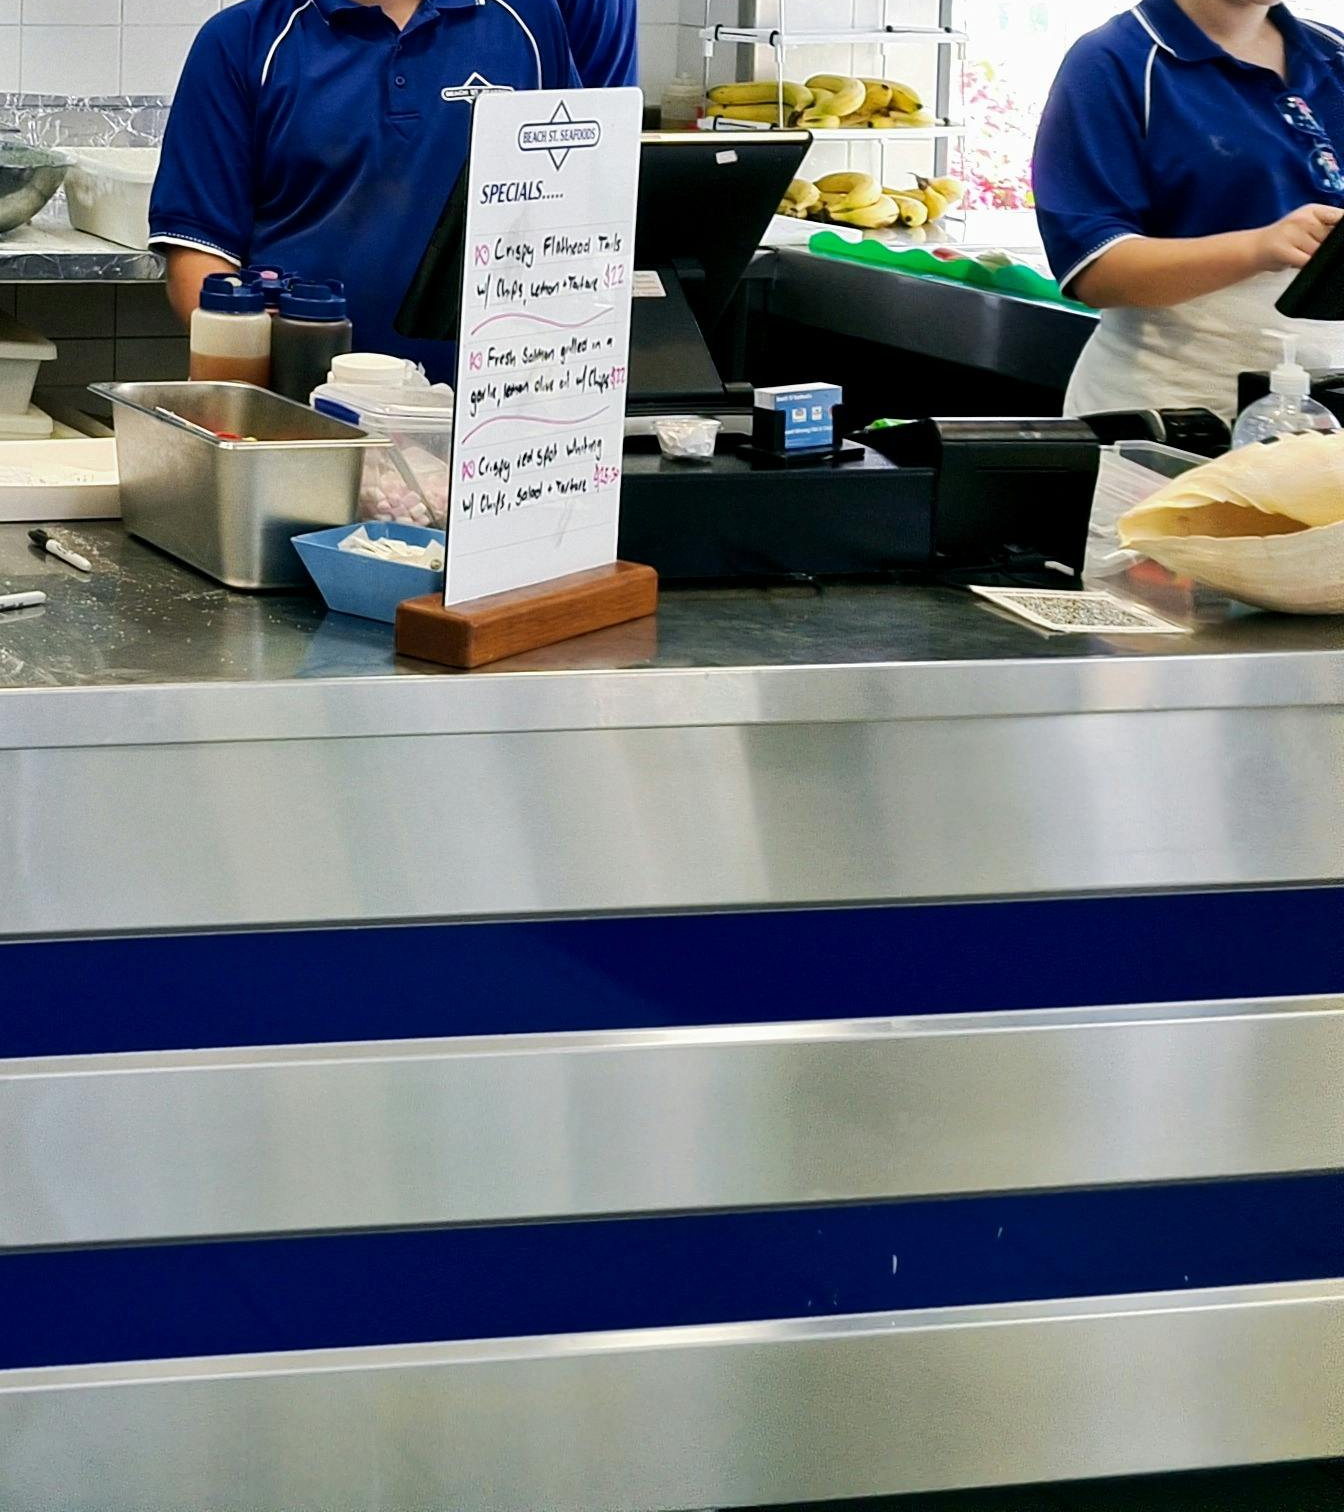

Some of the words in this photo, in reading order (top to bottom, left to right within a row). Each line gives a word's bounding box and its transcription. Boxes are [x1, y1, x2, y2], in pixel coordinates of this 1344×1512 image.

[523, 130, 546, 143] BEACH
[561, 128, 595, 142] SEAFOODS
[495, 239, 534, 268] Crispy
[487, 347, 516, 366] Fresh
